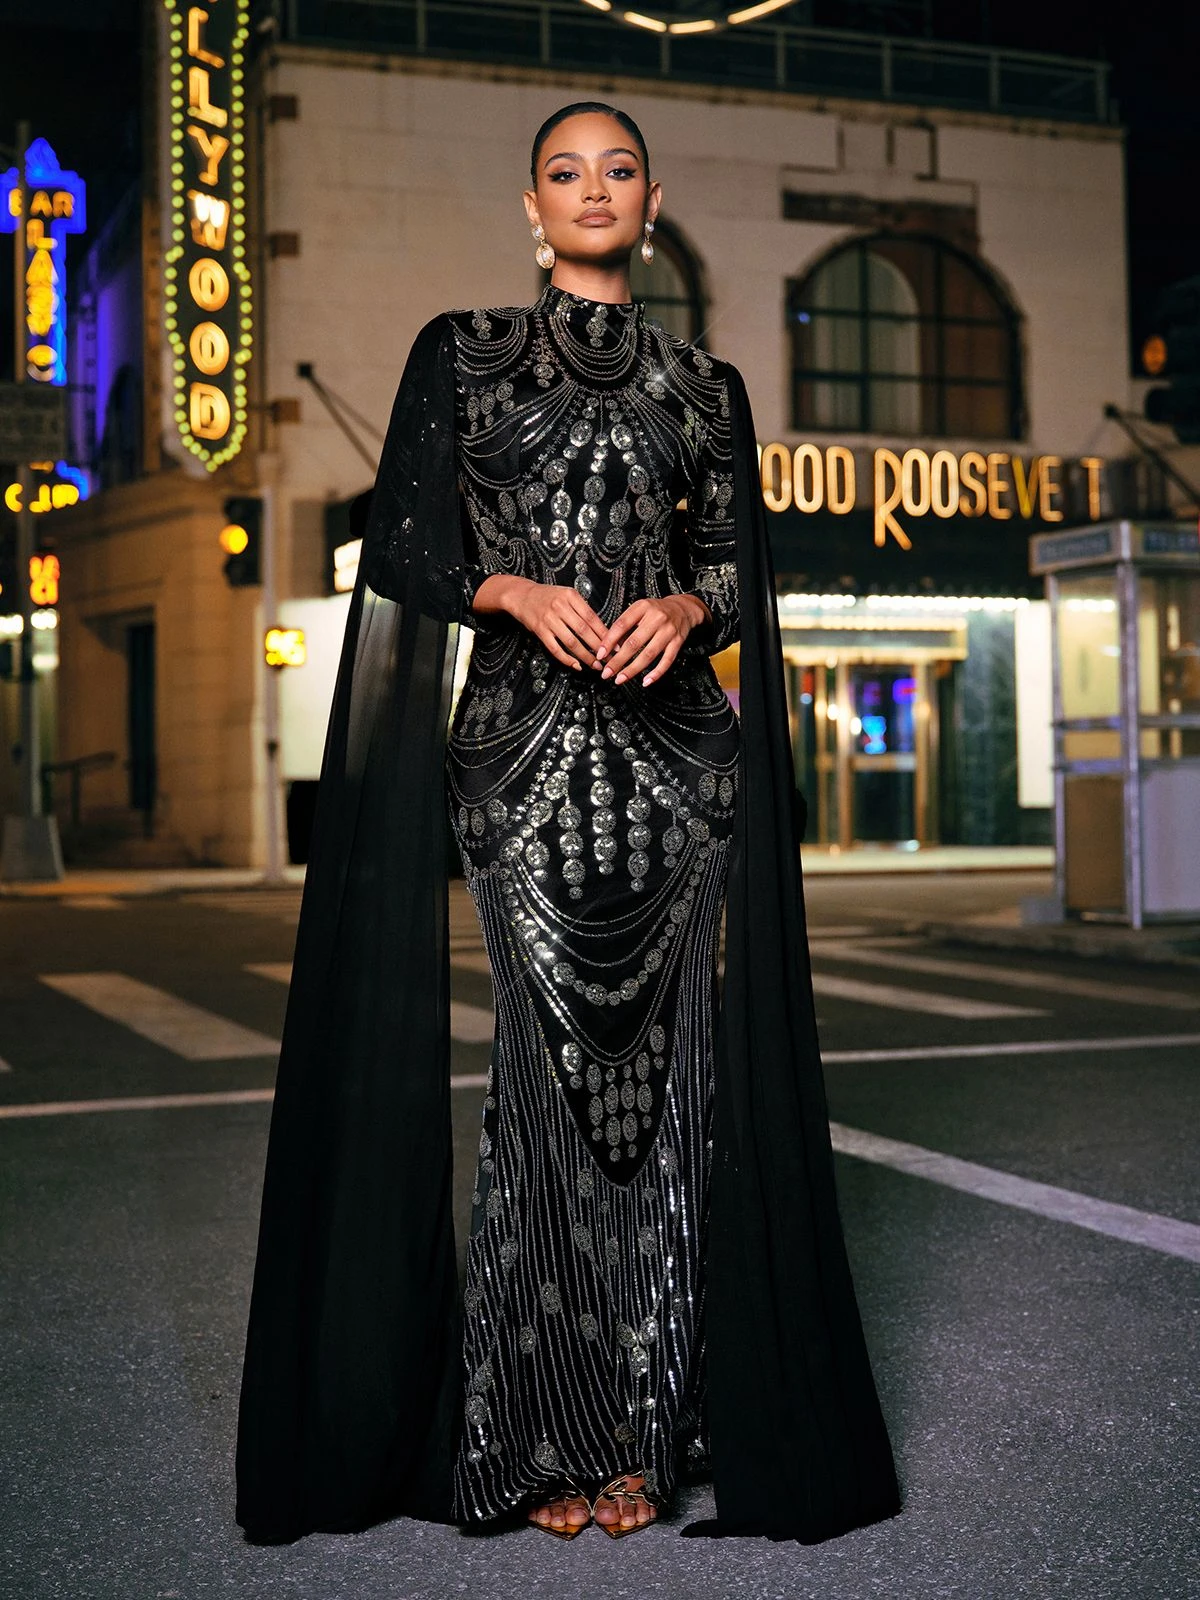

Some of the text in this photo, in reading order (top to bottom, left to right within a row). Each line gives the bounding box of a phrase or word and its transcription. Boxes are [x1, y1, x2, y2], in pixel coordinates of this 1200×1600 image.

[186, 0, 231, 440] LLYWOOD
[757, 442, 1104, 551] OOD ROOSEVET
